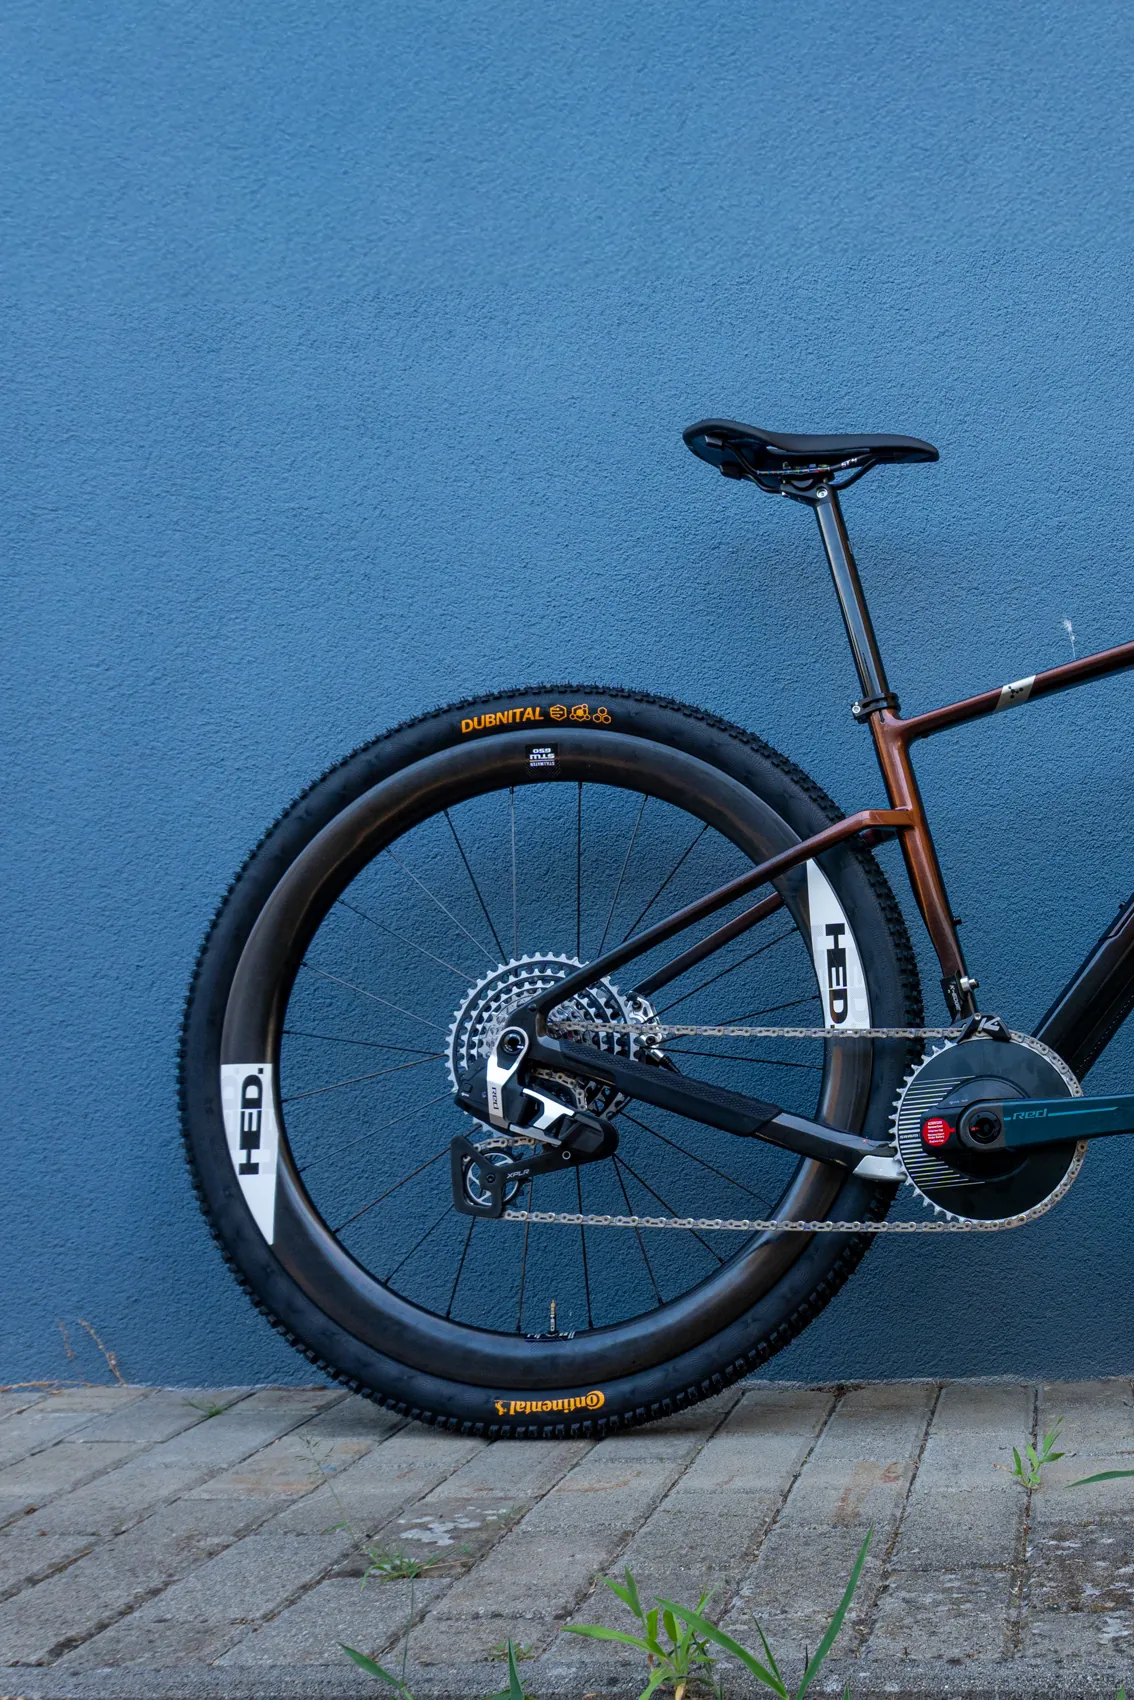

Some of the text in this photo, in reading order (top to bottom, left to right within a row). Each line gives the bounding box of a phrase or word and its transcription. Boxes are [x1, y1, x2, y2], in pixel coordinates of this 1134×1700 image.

[461, 707, 544, 734] DUBNITAL
[506, 1168, 530, 1179] XPLR
[509, 1390, 605, 1415] Continental
